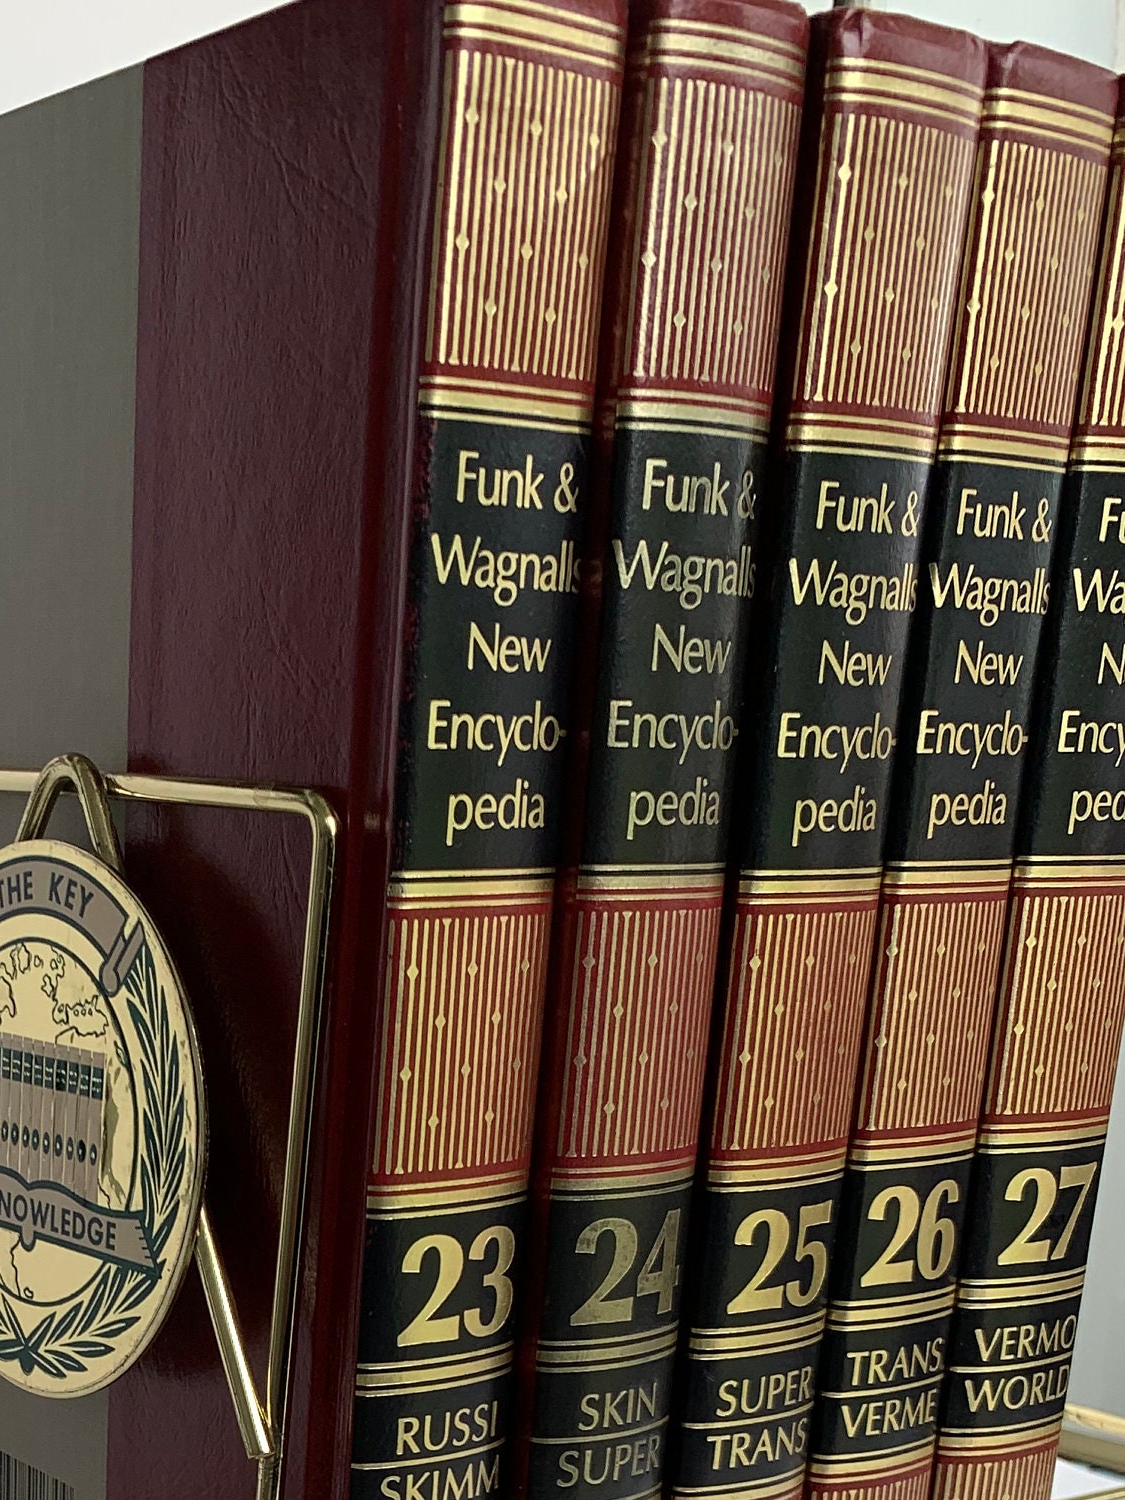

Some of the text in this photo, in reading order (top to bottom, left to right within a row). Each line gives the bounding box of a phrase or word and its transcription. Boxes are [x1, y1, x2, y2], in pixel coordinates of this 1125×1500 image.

[456, 450, 579, 513] Funk &
[642, 458, 757, 519] Funk &
[816, 480, 921, 537] Funk &
[957, 488, 1053, 543] Funk &
[613, 539, 756, 610] Wagnalls
[789, 558, 918, 625] Wagnalls
[929, 562, 1051, 627] Wagnalls
[467, 621, 551, 673] New
[652, 624, 732, 674] New
[818, 639, 892, 686] New
[954, 639, 1024, 686] New
[427, 699, 567, 767] Encyclo-
[607, 699, 739, 765] Encyclo-
[777, 712, 897, 774] Encyclo-
[917, 709, 1028, 769] Encyclo-
[446, 778, 545, 846] pedia
[627, 777, 719, 840] pedia
[792, 785, 876, 847] pedia
[928, 779, 1006, 839] pedia
[49, 872, 94, 919] KEY
[860, 1179, 959, 1288] 26
[997, 1161, 1098, 1266] 27
[397, 1225, 515, 1348] 23
[570, 1208, 681, 1326] 24
[727, 1199, 832, 1315] 25
[847, 1337, 944, 1386] TRANS
[975, 1314, 1077, 1362] VERMO
[578, 1383, 657, 1431] SKIN
[716, 1366, 812, 1416] SUPER
[841, 1388, 937, 1438] VERME
[964, 1365, 1070, 1412] WORLD
[396, 1400, 498, 1455] RUSSI
[707, 1417, 807, 1470] TRANS
[557, 1434, 661, 1488] SUPER
